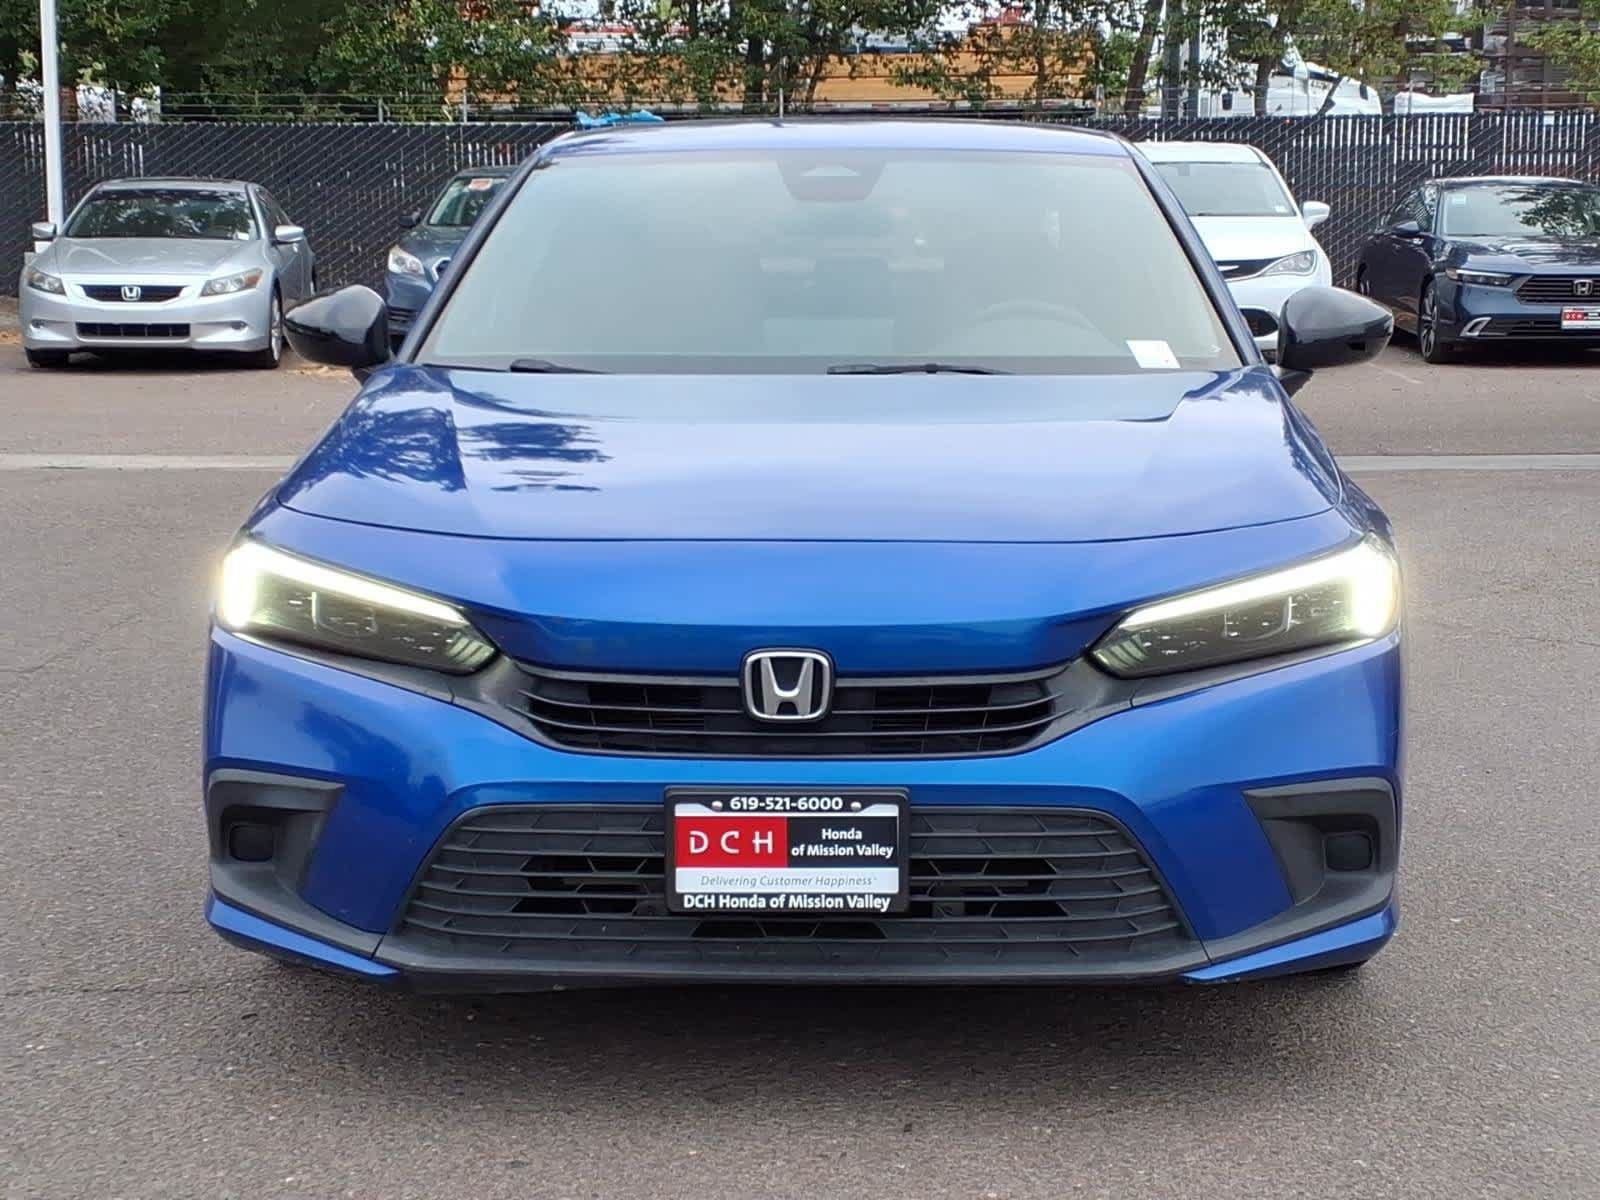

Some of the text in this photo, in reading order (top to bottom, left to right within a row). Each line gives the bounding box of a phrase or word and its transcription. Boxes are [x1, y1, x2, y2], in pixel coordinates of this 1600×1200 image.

[757, 654, 817, 717] H
[730, 797, 843, 810] 619-521-6000
[822, 828, 862, 840] Honda
[792, 845, 893, 858] of Mission Valley
[701, 875, 872, 887] Delivering Customer Happiness
[684, 895, 890, 912] DCH Honda of Mission Valley
